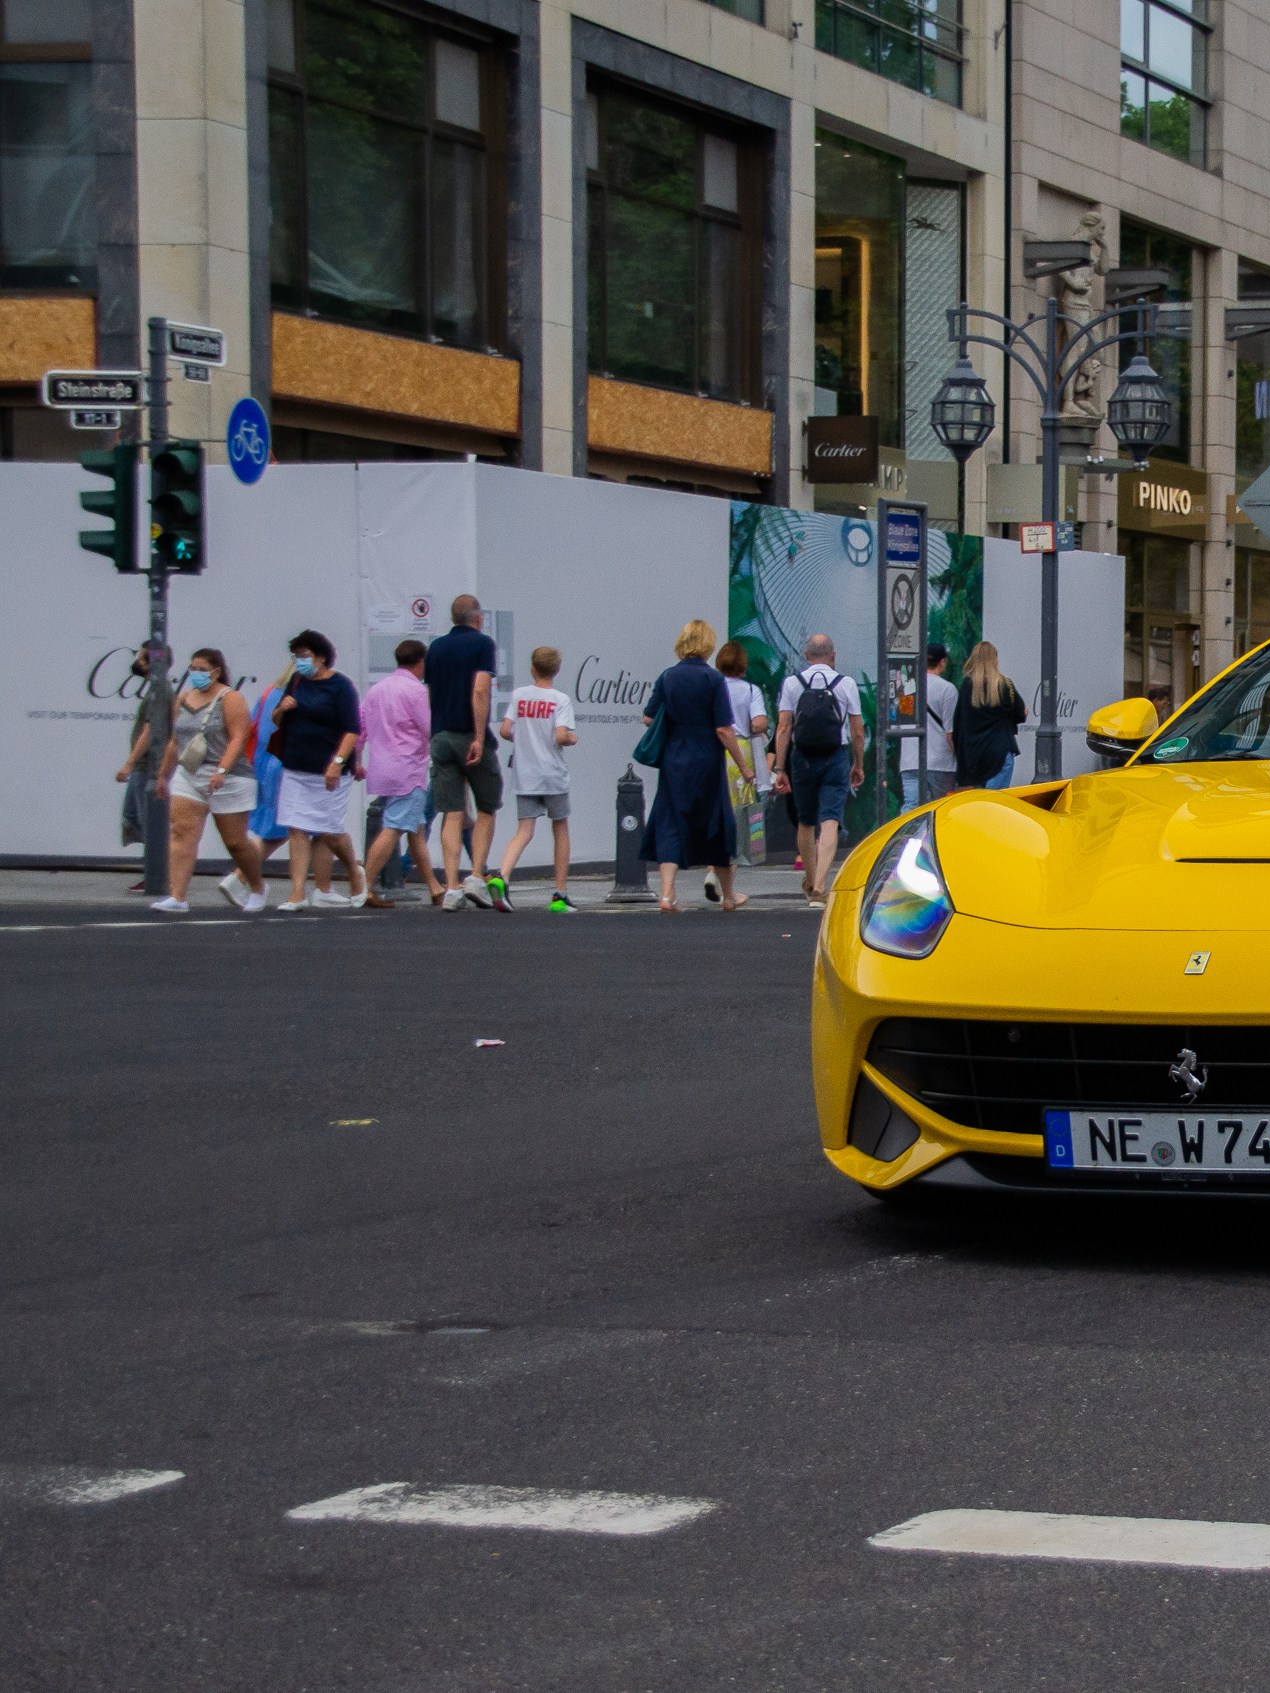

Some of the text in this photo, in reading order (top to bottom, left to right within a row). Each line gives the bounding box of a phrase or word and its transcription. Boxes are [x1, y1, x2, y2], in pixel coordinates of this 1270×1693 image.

[58, 382, 133, 399] Steinstraße
[814, 442, 867, 457] Cartier
[1139, 481, 1191, 515] PINKO
[894, 634, 911, 648] ZONE
[575, 654, 652, 705] Cartier
[517, 700, 557, 718] SURF
[1056, 1144, 1066, 1157] D
[1088, 1117, 1148, 1162] NE
[1177, 1118, 1205, 1164] W
